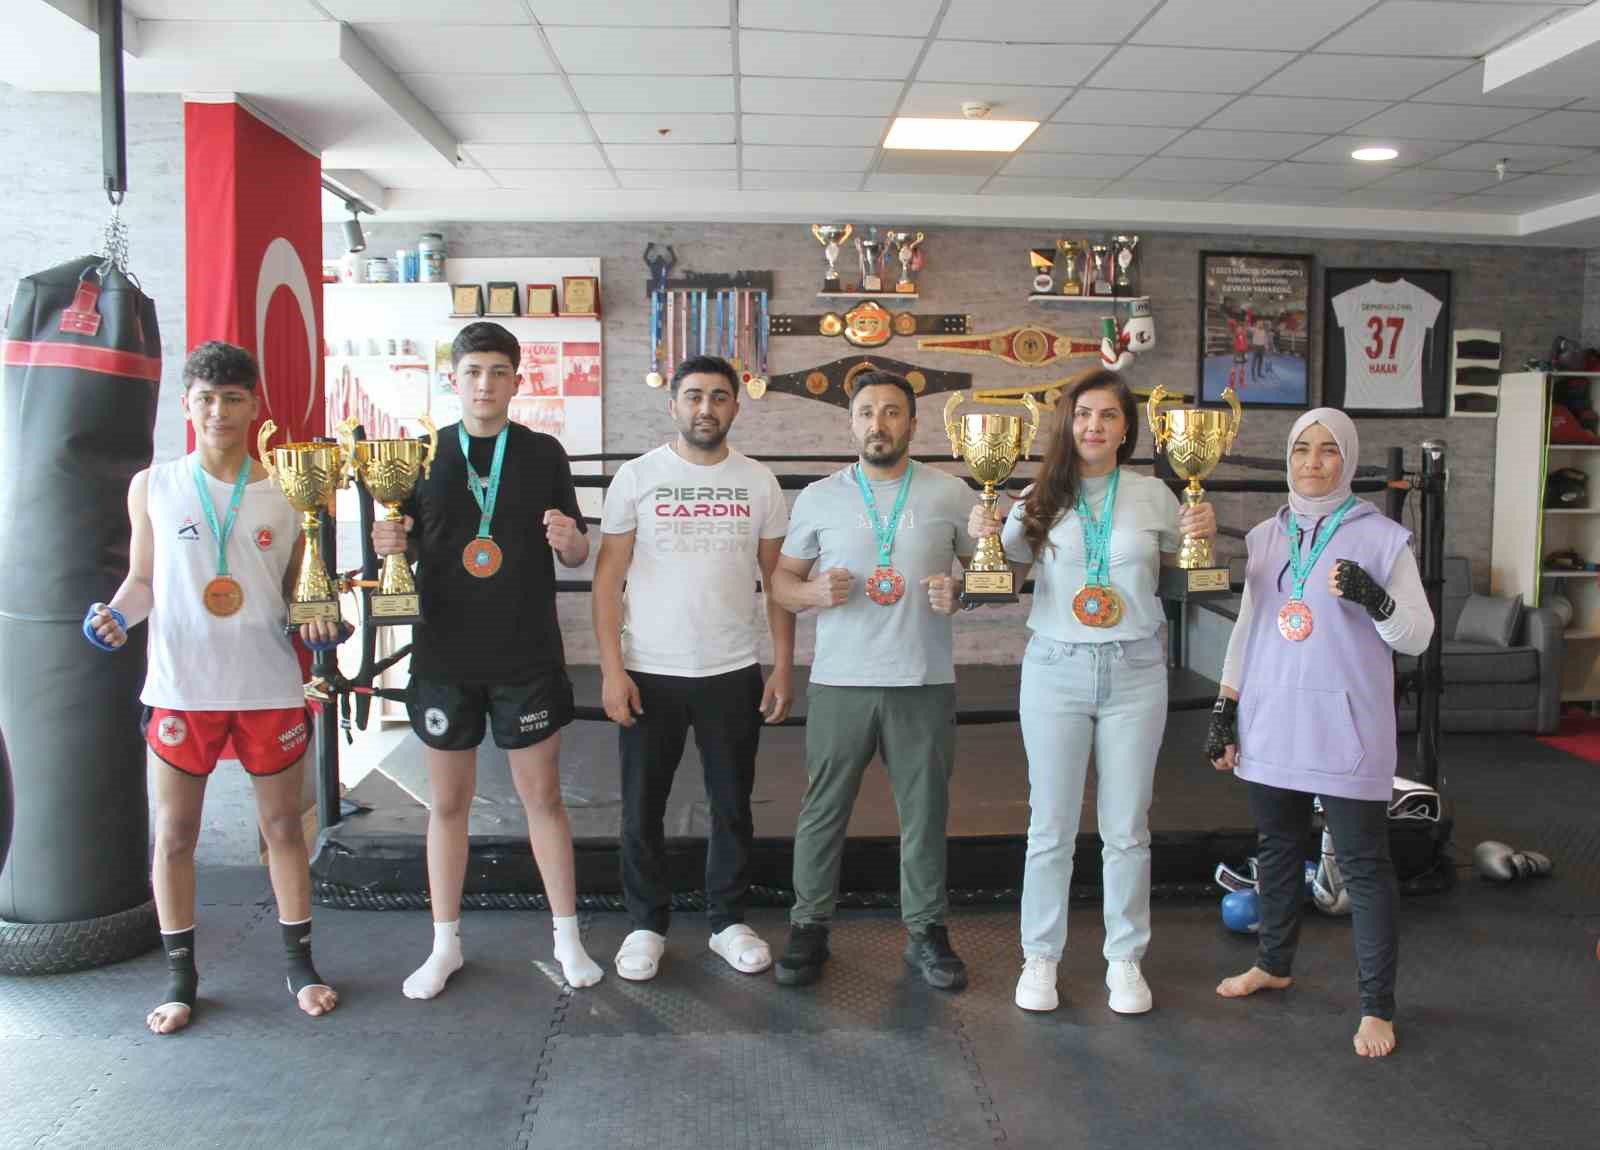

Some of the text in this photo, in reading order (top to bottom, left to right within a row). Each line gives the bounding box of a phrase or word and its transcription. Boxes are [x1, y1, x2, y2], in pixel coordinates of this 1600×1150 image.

[1365, 315, 1405, 359] 37
[1368, 363, 1398, 374] HAKAN
[656, 487, 749, 501] PIERRE
[656, 503, 751, 517] CARDIN
[656, 521, 751, 536] PIERRE
